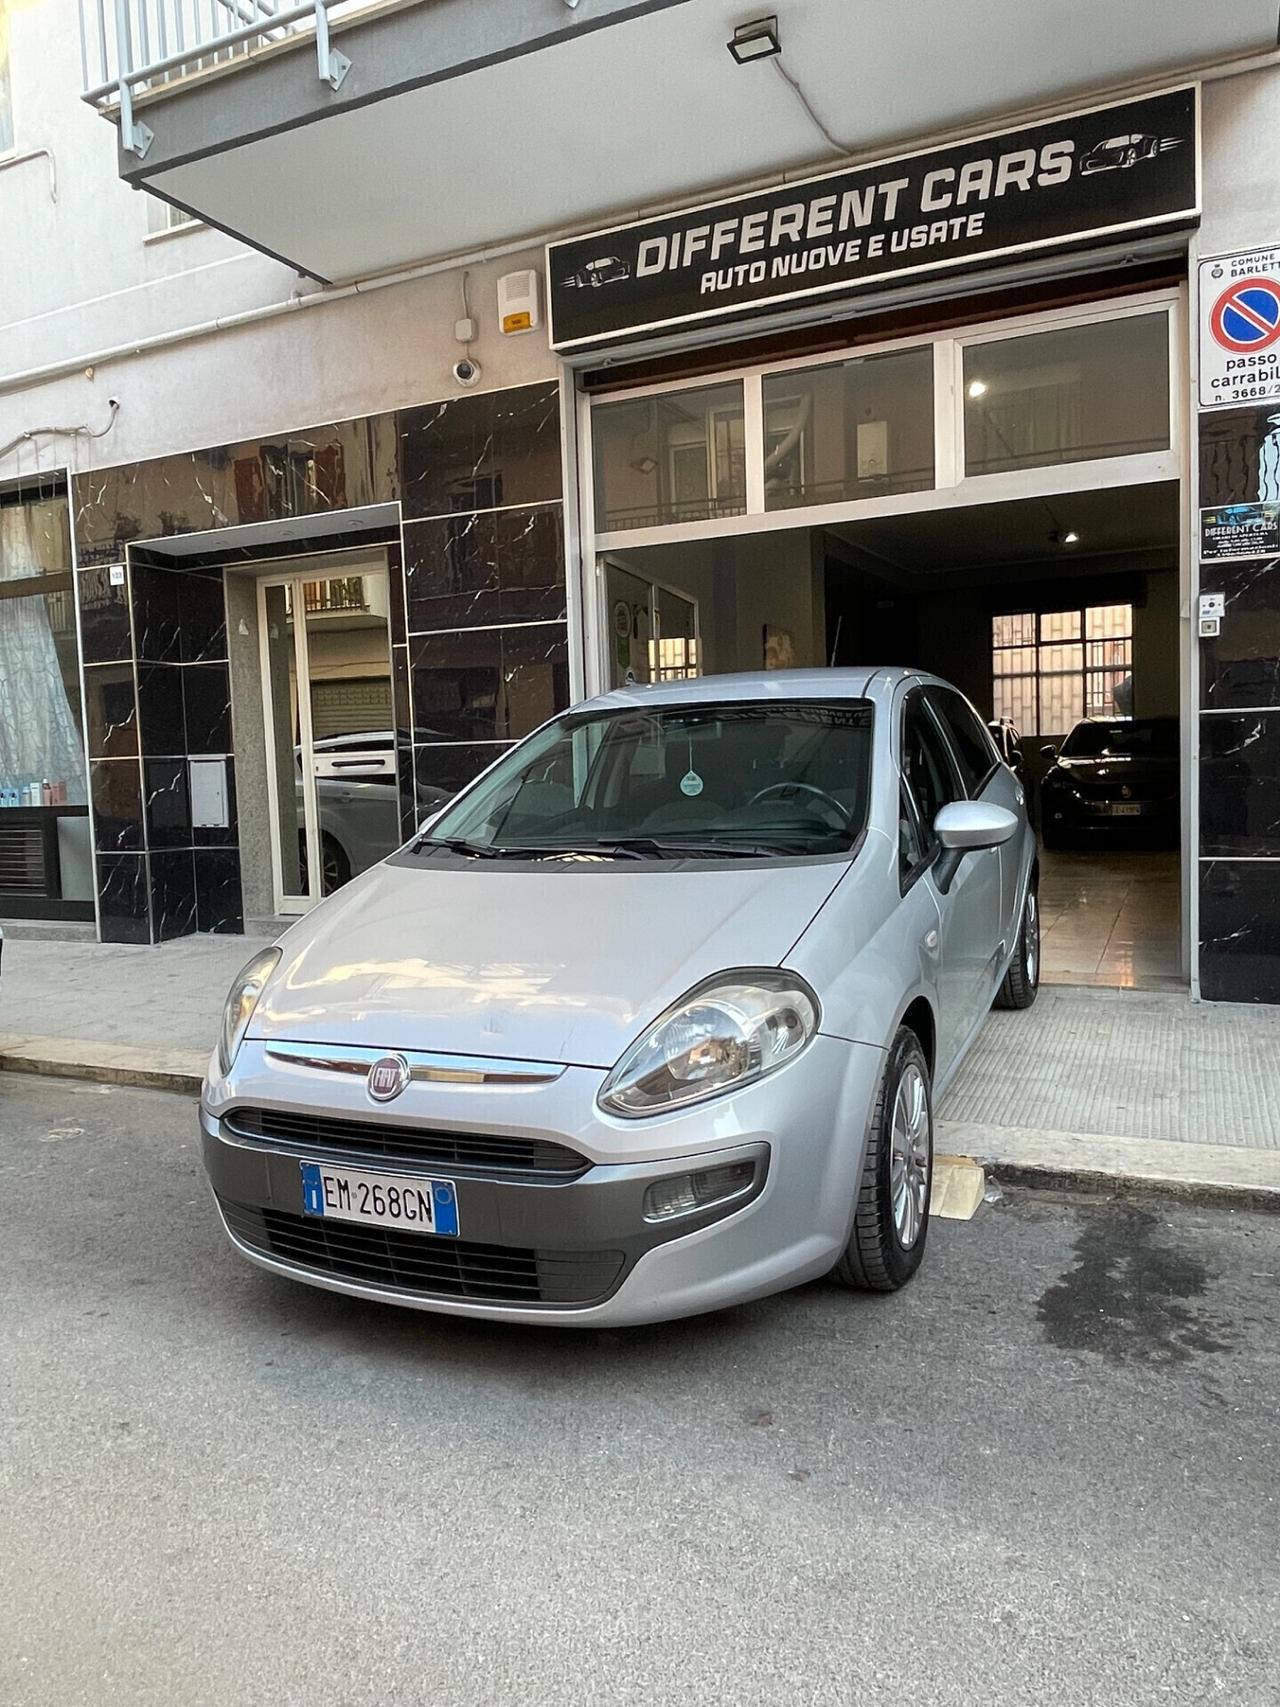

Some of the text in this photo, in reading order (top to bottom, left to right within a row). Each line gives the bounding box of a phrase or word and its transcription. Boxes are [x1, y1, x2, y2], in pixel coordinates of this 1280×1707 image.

[636, 140, 1075, 278] DIFFERENT CARS
[700, 212, 985, 294] AUTO NUOVE E USATE
[1231, 253, 1275, 267] COMUNE
[1226, 353, 1277, 372] passo
[1205, 521, 1278, 537] DIFFERENT CARS
[374, 1067, 398, 1088] FIAT
